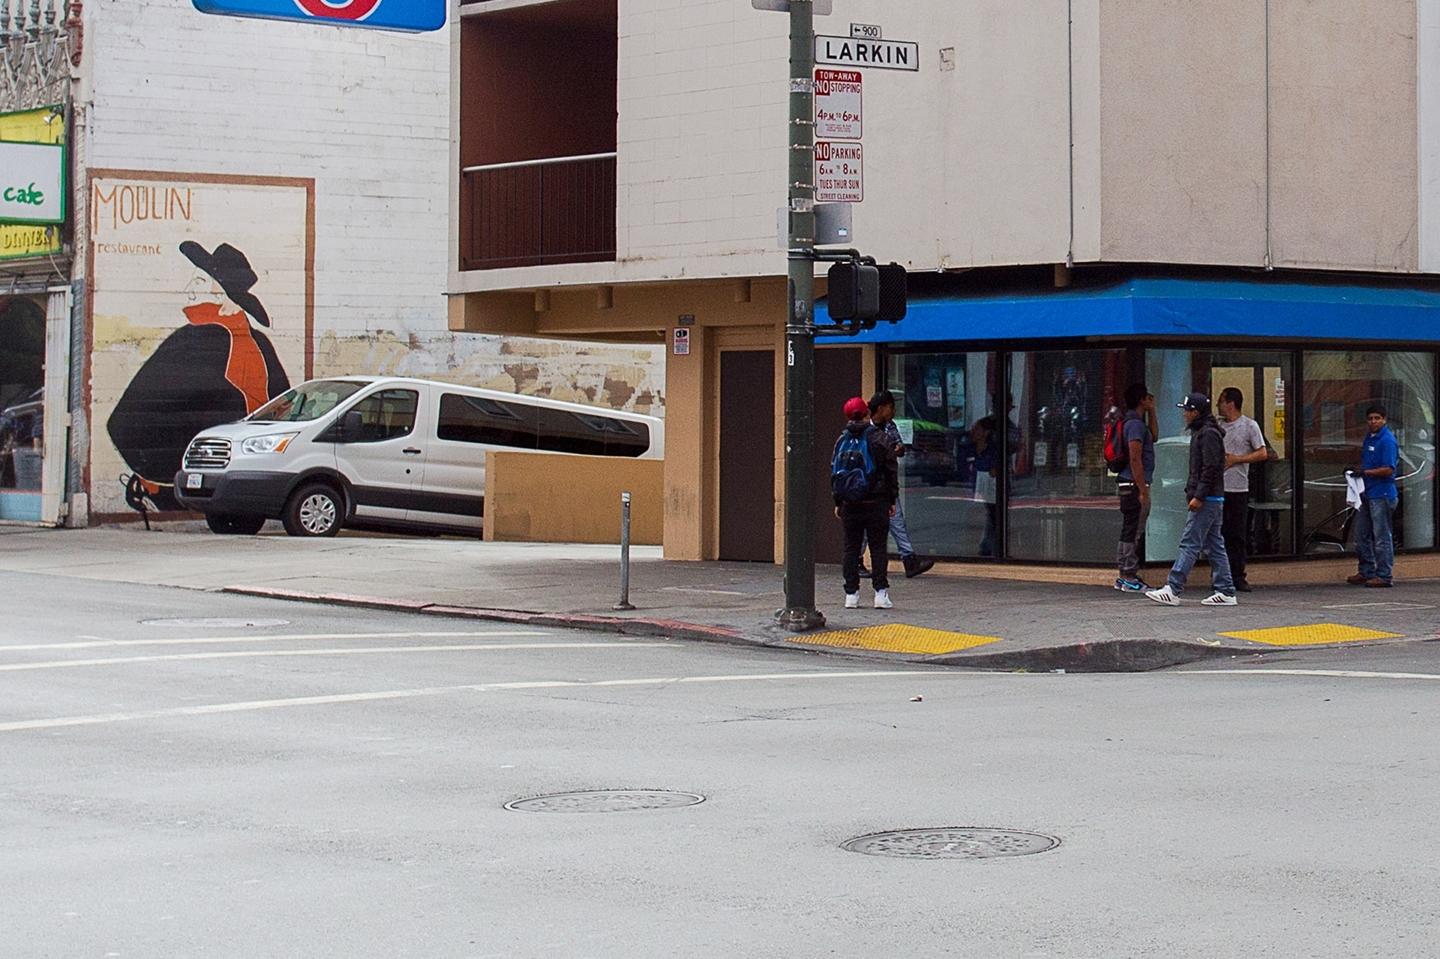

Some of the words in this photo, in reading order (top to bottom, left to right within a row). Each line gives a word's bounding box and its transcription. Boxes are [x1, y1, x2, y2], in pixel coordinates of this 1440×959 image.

[862, 26, 878, 37] 900
[826, 41, 908, 65] LARKIN
[820, 71, 857, 81] TOW-AWAY
[816, 80, 829, 94] NO
[830, 83, 861, 94] STOPPING
[816, 143, 830, 159] NO
[831, 147, 861, 160] PARKING
[848, 179, 860, 190] SUN
[3, 182, 44, 205] cafe
[94, 185, 192, 235] MOULIN
[97, 242, 162, 255] restaurant
